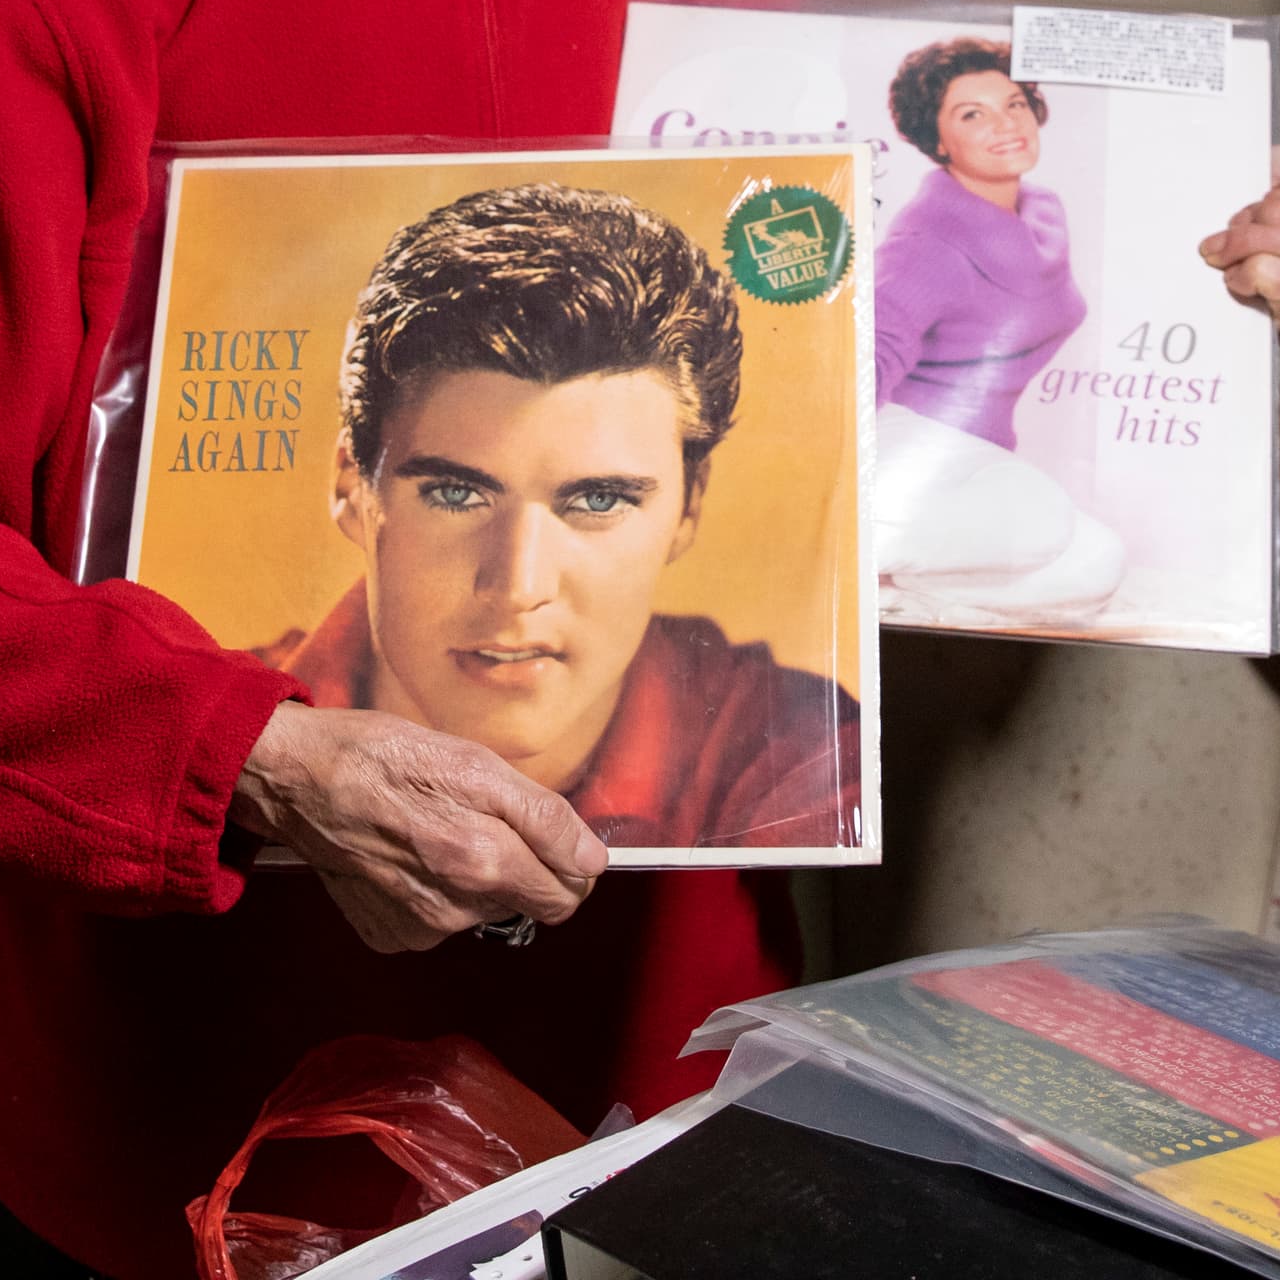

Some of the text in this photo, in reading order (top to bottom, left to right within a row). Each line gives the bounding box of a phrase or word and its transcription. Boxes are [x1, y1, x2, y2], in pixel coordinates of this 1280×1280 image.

[757, 243, 823, 269] LIBERTY
[766, 259, 828, 290] VALUE
[180, 329, 311, 371] RICKY
[1117, 321, 1197, 365] 40
[178, 379, 303, 421] SINGS
[1039, 368, 1225, 404] greatest
[1116, 405, 1201, 446] hits
[168, 429, 300, 472] AGAIN
[1169, 1057, 1222, 1078] QUICK
[1219, 1079, 1253, 1092] ME
